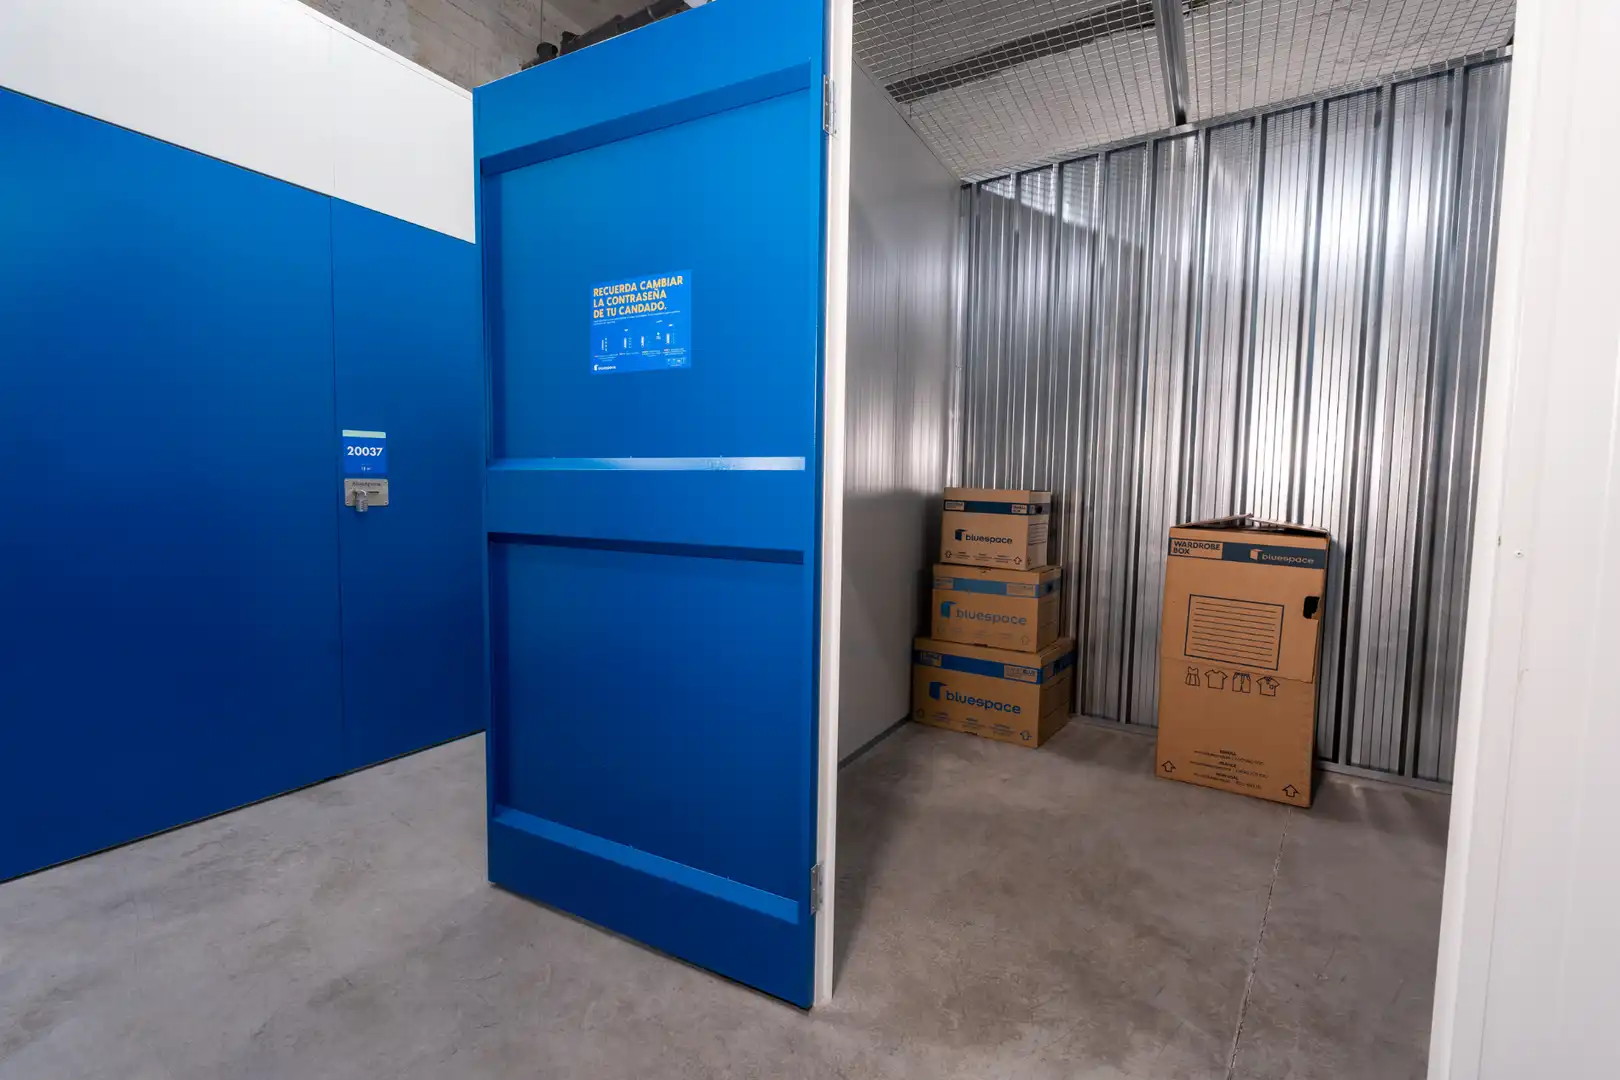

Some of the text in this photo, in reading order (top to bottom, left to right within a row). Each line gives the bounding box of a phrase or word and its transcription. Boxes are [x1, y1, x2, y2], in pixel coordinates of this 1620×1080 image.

[593, 275, 683, 297] RECUERDA CAMBIAR
[593, 287, 667, 308] LA CONTRASEÑA
[593, 309, 604, 318] DE
[606, 307, 616, 317] TU
[618, 301, 667, 315] CANDADO.
[347, 446, 383, 457] 20037
[965, 533, 1013, 545] bluespace
[1173, 540, 1220, 551] WARDROBE
[1173, 547, 1190, 555] BOX
[1262, 553, 1314, 565] bluespace
[956, 607, 1027, 626] bluespace
[946, 690, 1021, 715] bluespace
